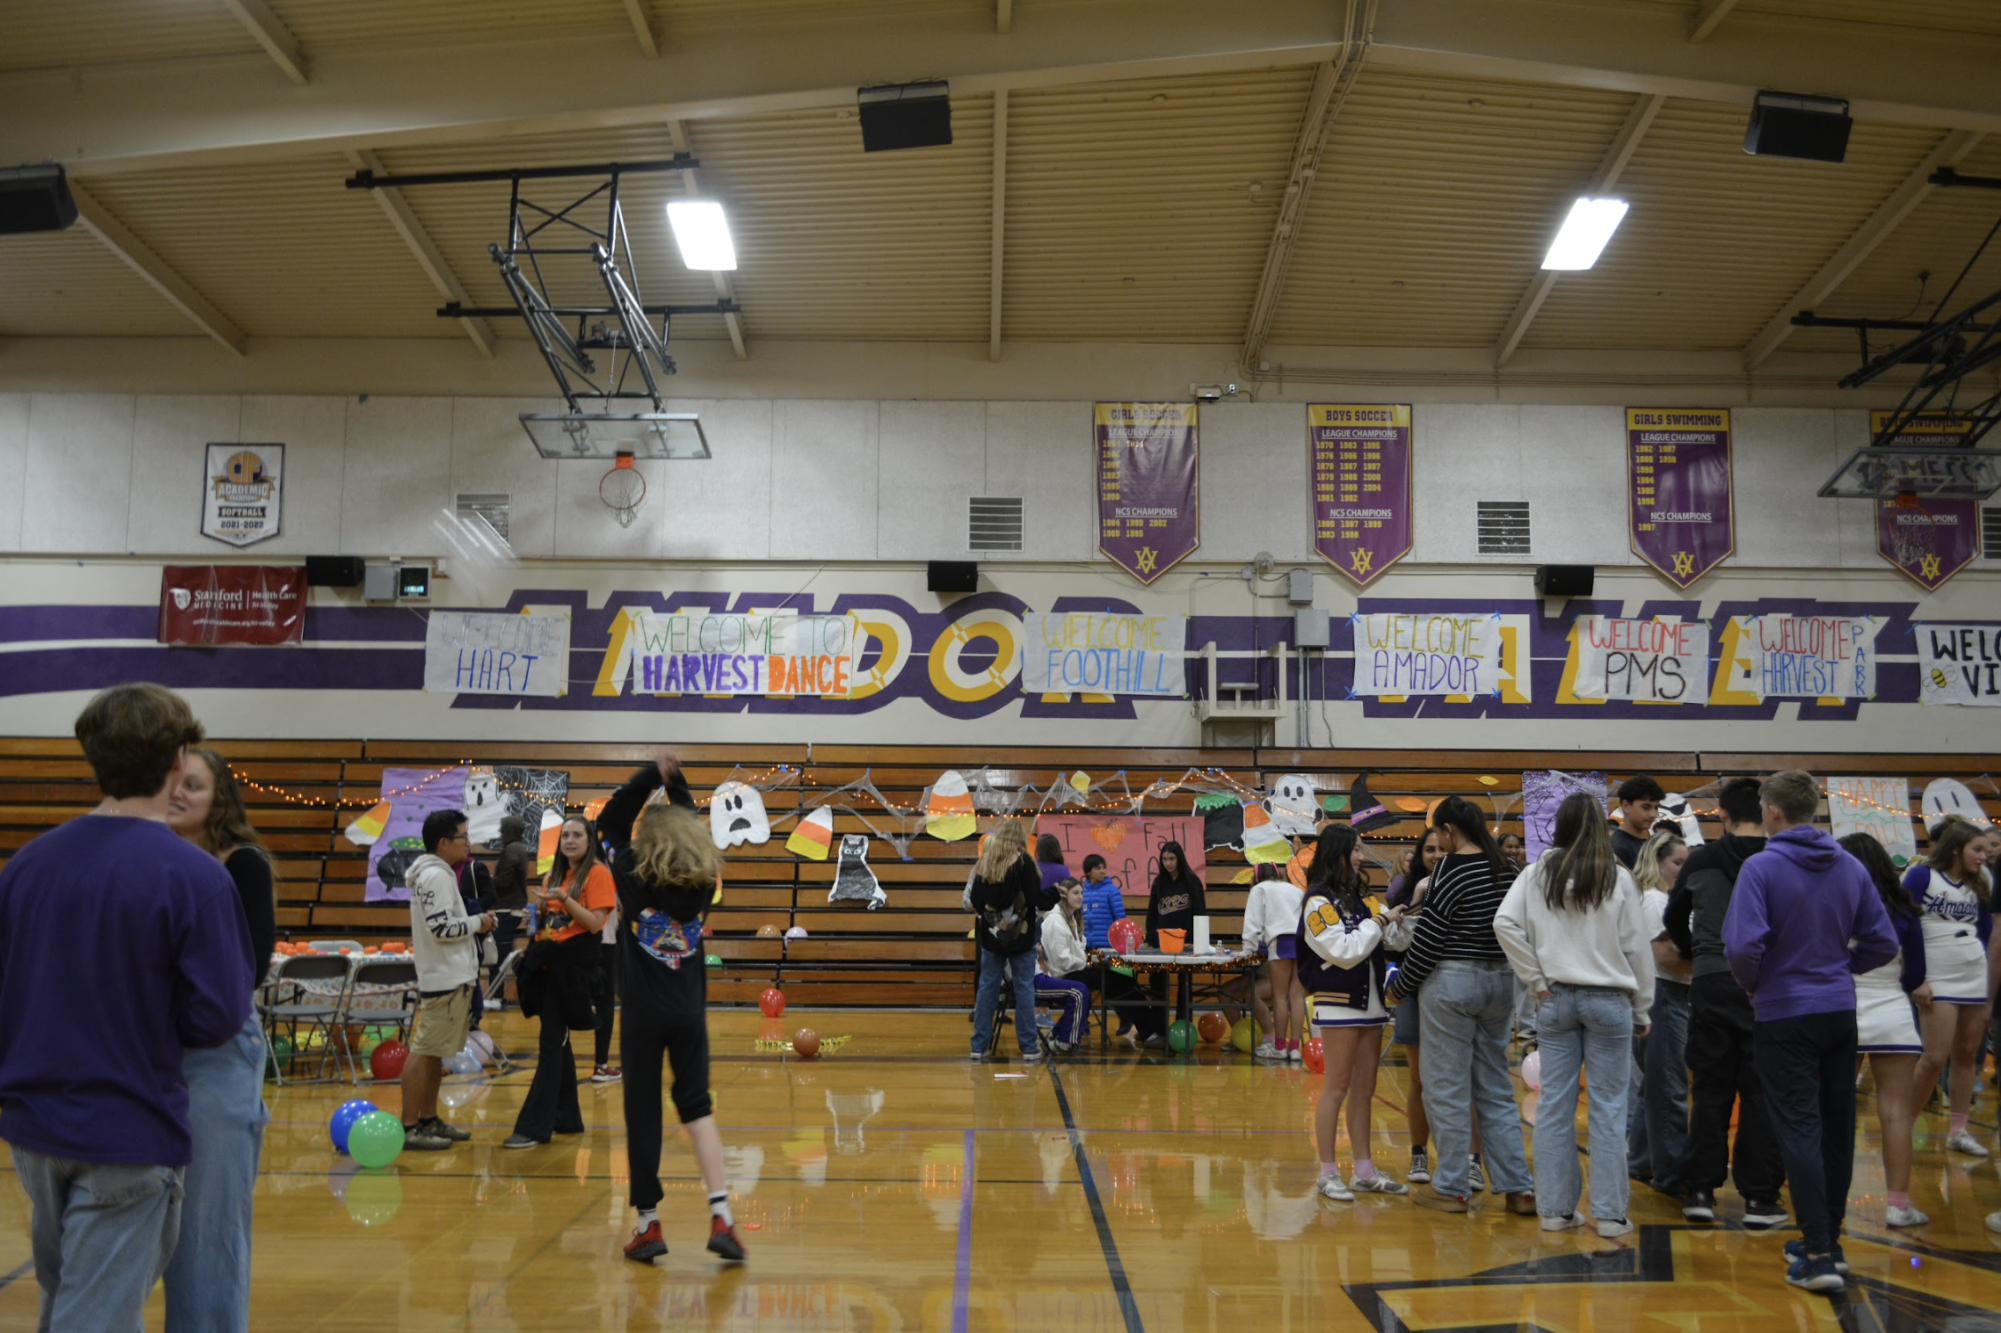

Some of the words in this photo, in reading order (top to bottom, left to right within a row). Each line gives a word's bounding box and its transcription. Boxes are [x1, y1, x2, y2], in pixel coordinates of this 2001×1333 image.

[1111, 409, 1139, 420] GIRLS
[1143, 409, 1182, 421] SOCCER
[1326, 410, 1352, 421] BOYS
[1355, 410, 1393, 422] SOCCER
[1634, 414, 1663, 425] GIRLS
[1666, 414, 1722, 426] SWIMMING
[1108, 428, 1138, 437] LEAGUE
[1139, 428, 1184, 437] CHAMPIONS
[1322, 429, 1351, 438] LEAGUE
[1352, 429, 1398, 439] CHAMPIONS
[1640, 433, 1670, 442] LEAGUE
[1671, 433, 1715, 442] CHAMPIONS
[1889, 436, 1914, 444] AGUE
[1915, 436, 1960, 444] CHAMPIONS
[228, 452, 263, 484] CIF
[219, 483, 268, 496] ACADEMIC
[221, 507, 264, 516] SOFTBALL
[1116, 508, 1130, 516] NCS
[1132, 508, 1178, 516] CHAMPIONS
[1330, 509, 1345, 517] NCS
[1346, 509, 1392, 518] CHAMPIONS
[1650, 512, 1666, 520] NCS
[1666, 512, 1712, 520] CHAMPIONS
[221, 520, 264, 529] 2021-2022
[195, 588, 242, 601] Stanford
[252, 591, 277, 600] Health
[279, 592, 297, 600] Care
[194, 602, 242, 610] MEDICINE
[442, 614, 565, 657] WELCOME
[640, 615, 787, 656] WELCOME
[804, 616, 846, 655] TO
[1041, 614, 1168, 650] WELCOME
[1366, 614, 1484, 659] WELCOME
[1589, 619, 1695, 656] WELCOME
[1759, 618, 1851, 661] WELCOME
[456, 648, 539, 692] HART
[642, 653, 764, 692] HARVEST
[768, 655, 851, 693] DANCE
[1047, 648, 1171, 692] FOOTHILL
[1373, 650, 1479, 692] AMADOR
[1605, 651, 1686, 700] PMS
[1762, 651, 1839, 695] HARVEST
[1838, 778, 1899, 809] HAPPY
[1059, 823, 1076, 852] I
[1143, 822, 1187, 851] Fall
[1927, 894, 1977, 916] Amado
